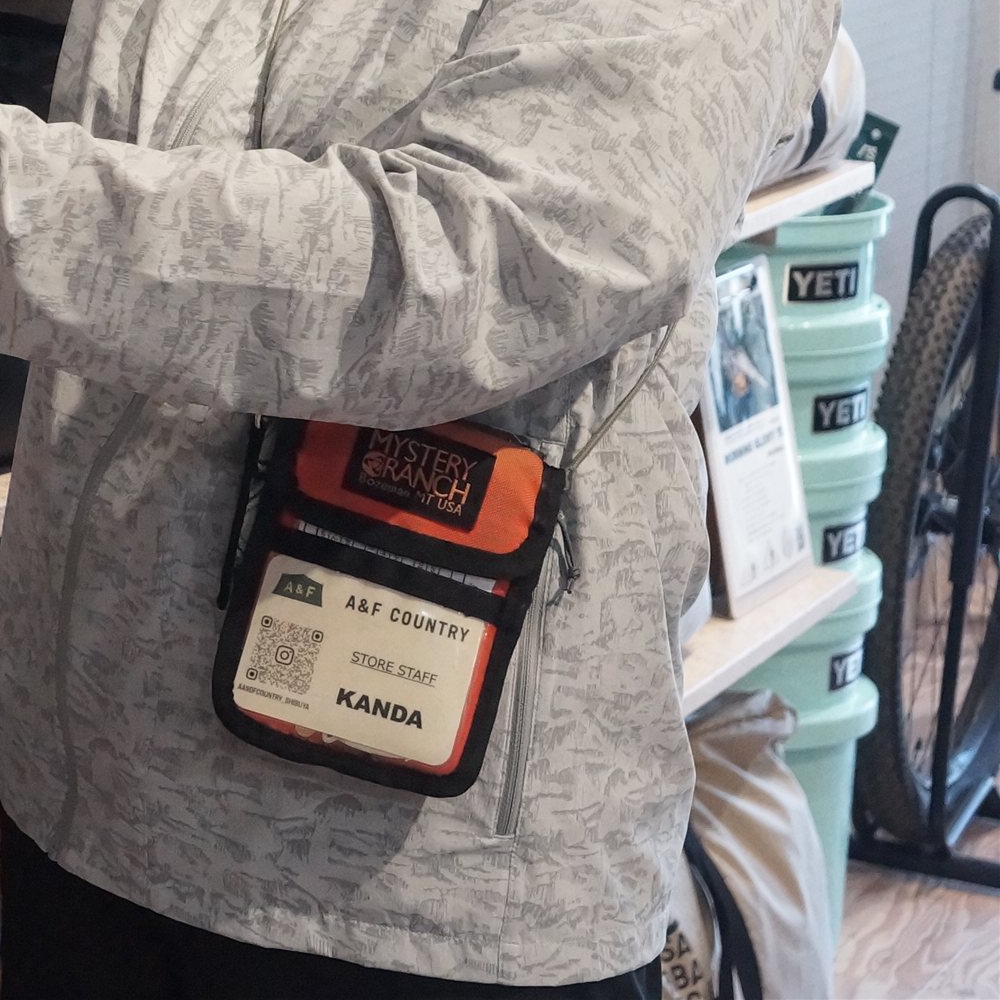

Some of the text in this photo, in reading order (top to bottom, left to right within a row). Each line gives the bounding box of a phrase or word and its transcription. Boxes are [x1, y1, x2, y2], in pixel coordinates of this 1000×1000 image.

[791, 268, 857, 298] YETI
[818, 391, 868, 427] YETI
[369, 429, 478, 480] MYSTERY
[382, 456, 471, 504] RANCH
[437, 498, 462, 516] USA
[283, 579, 316, 598] A&F
[345, 595, 470, 643] A&F COUNTRY
[350, 651, 439, 685] STORE STAFF
[336, 687, 423, 729] KANDA
